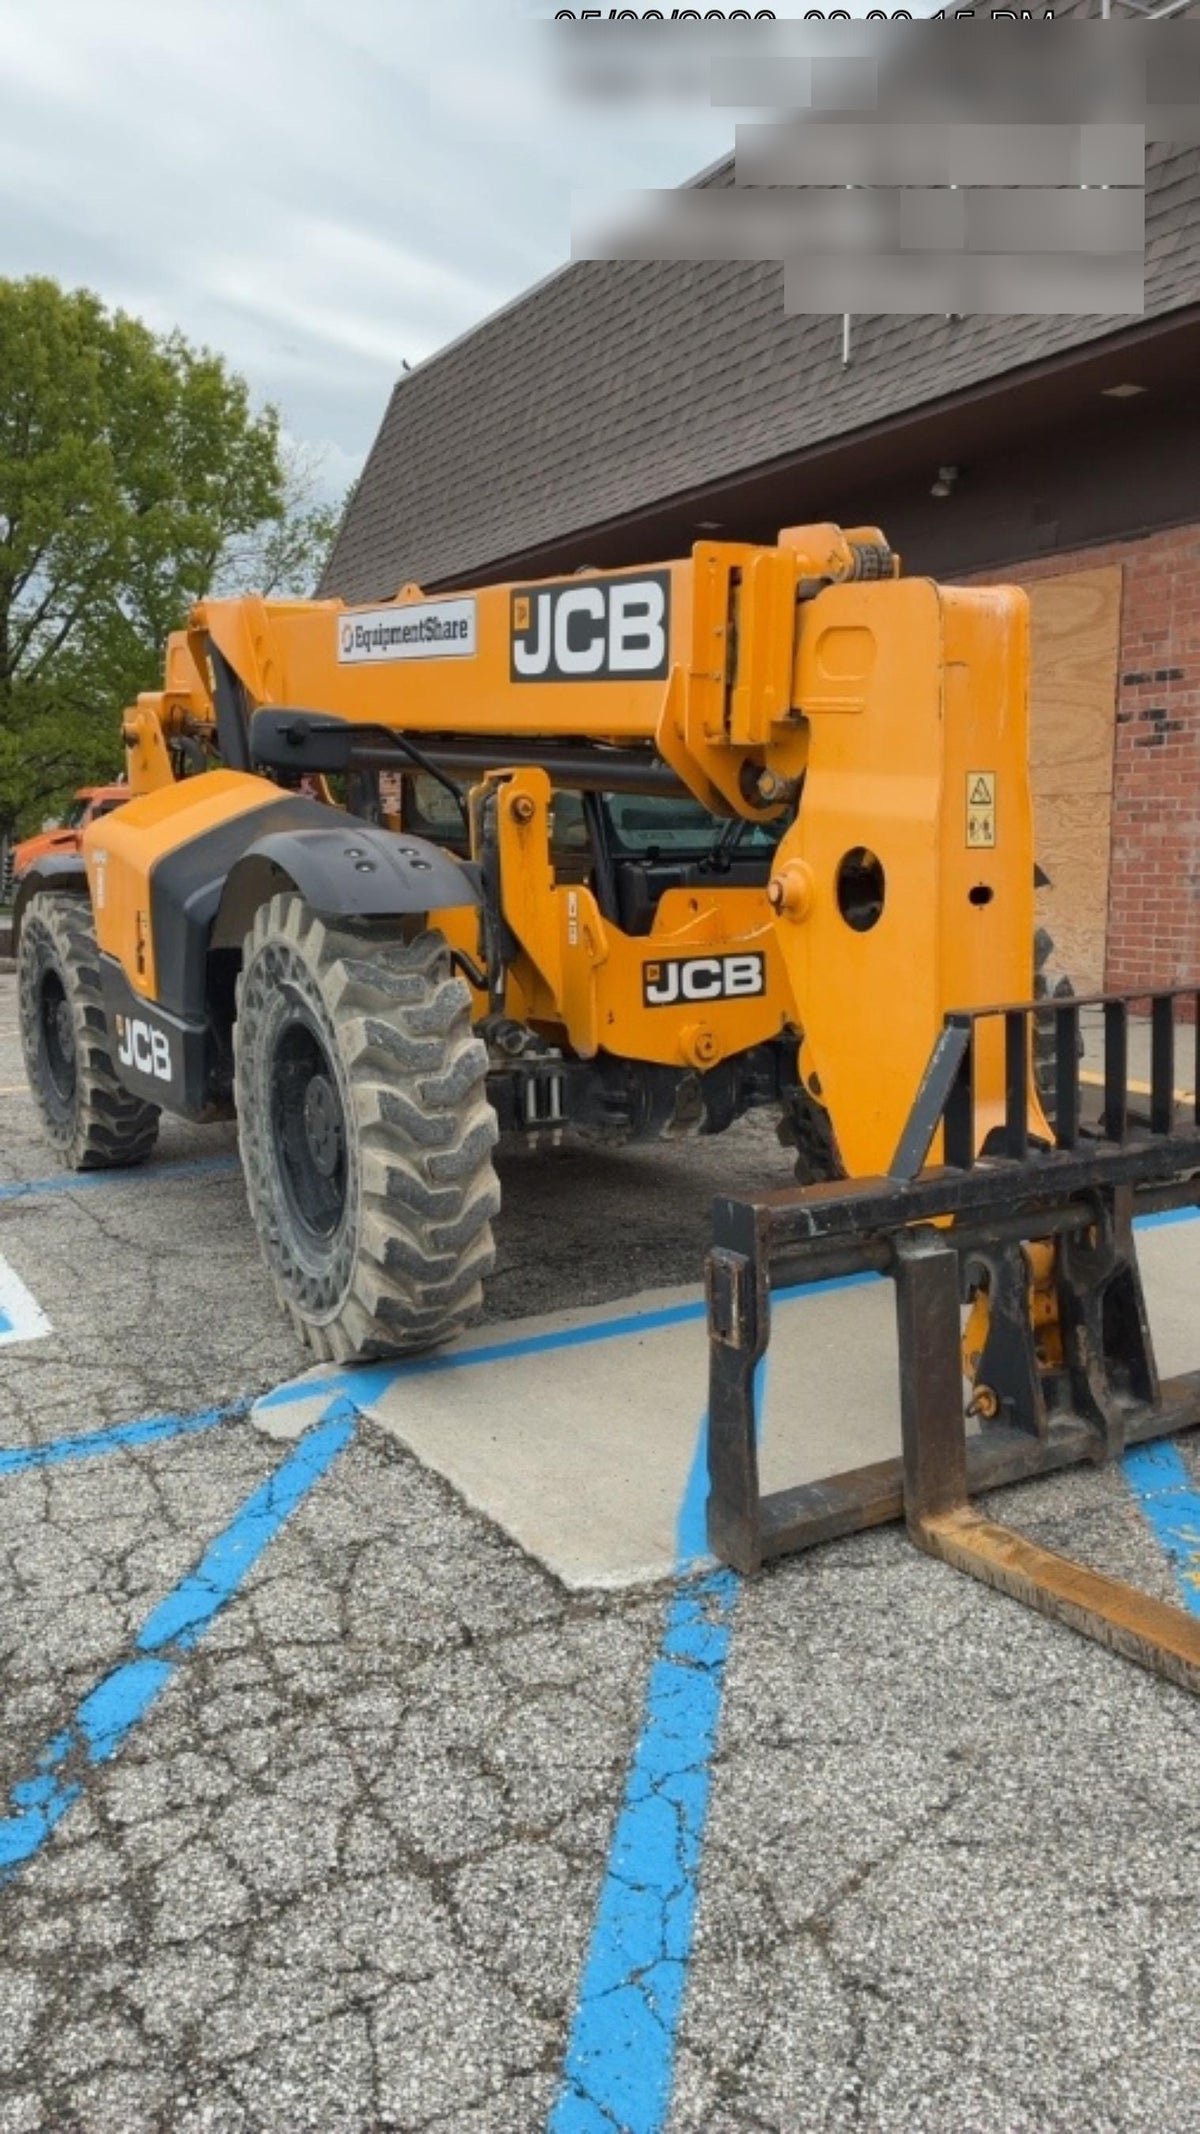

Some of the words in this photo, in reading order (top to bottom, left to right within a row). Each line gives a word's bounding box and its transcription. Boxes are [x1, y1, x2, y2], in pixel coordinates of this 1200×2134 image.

[355, 616, 469, 652] EquipmentShare
[514, 580, 666, 675] JCB
[646, 955, 763, 1004] JCB
[118, 1016, 172, 1083] JCB
